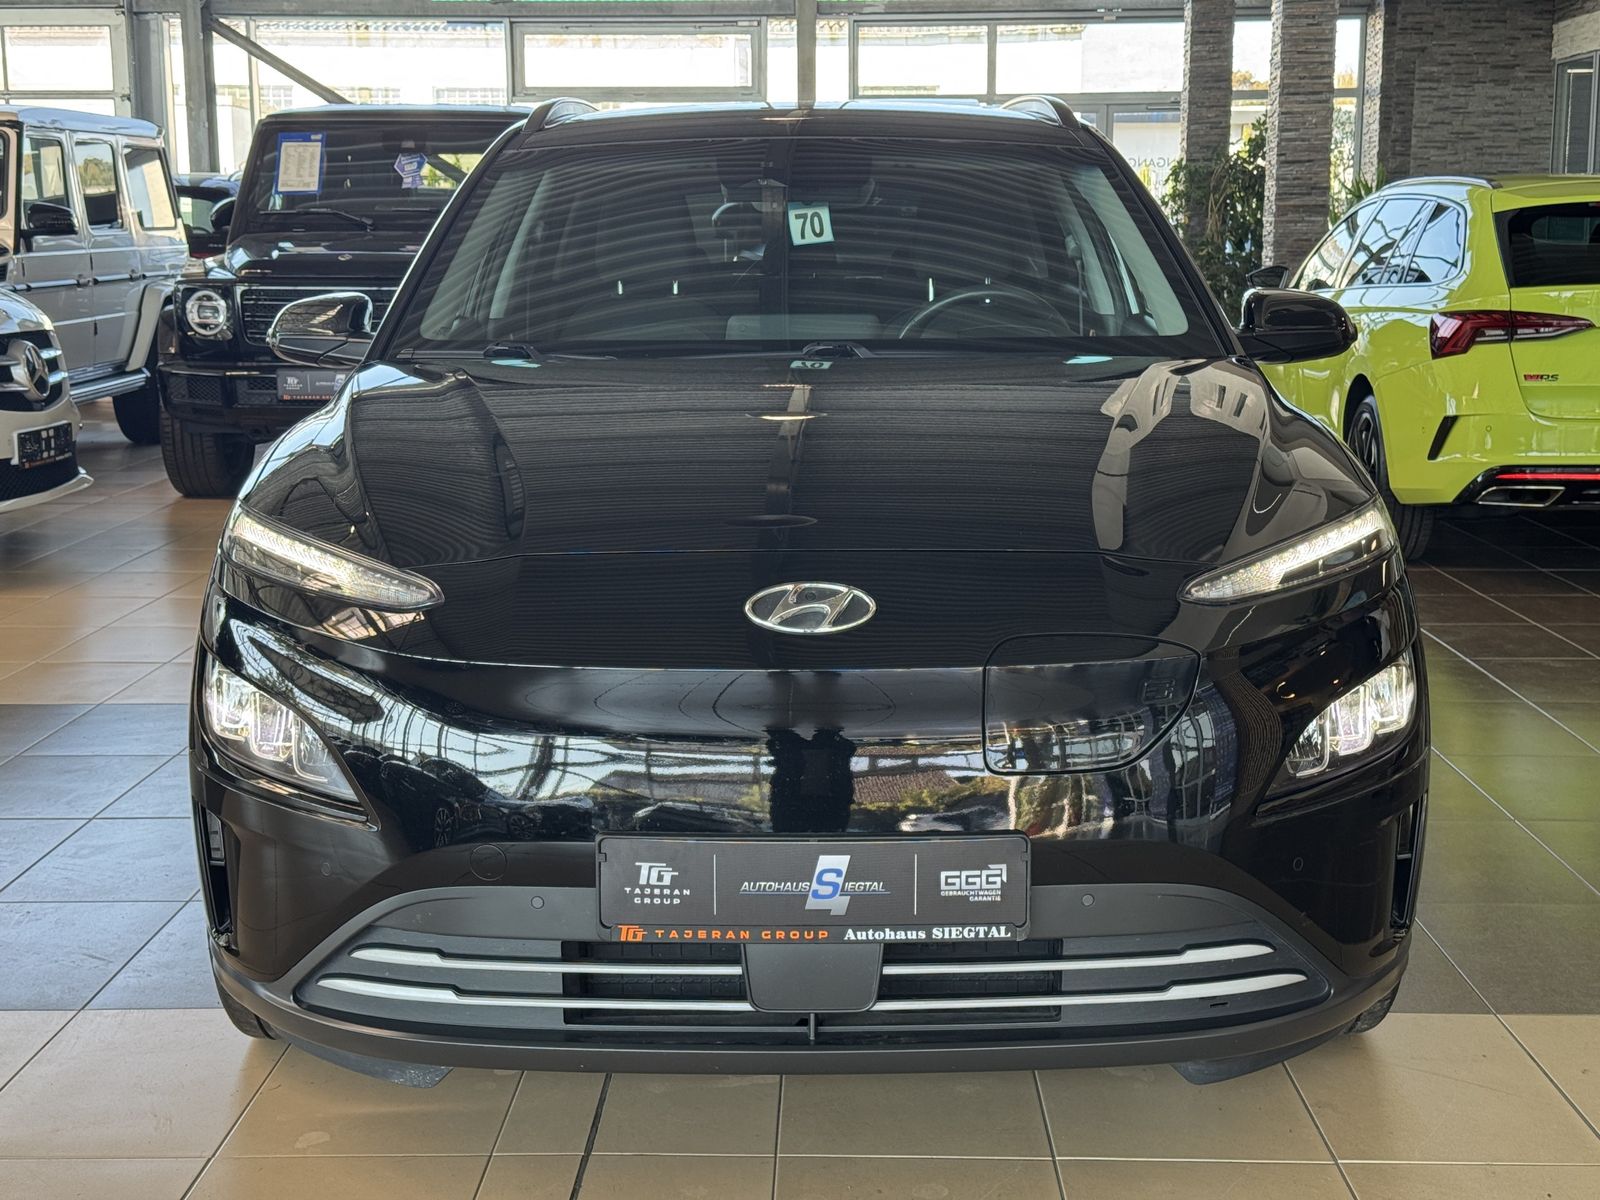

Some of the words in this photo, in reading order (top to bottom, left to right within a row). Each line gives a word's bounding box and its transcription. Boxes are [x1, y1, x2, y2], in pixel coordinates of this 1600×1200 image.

[794, 211, 825, 240] 70
[635, 862, 679, 885] TG
[940, 869, 1002, 890] GGG
[624, 887, 690, 896] TAJERAN
[740, 881, 810, 892] AUTOHAUS
[940, 889, 1002, 897] GEBRAUCHTWAGEN
[634, 897, 680, 905] GROUP
[618, 925, 648, 942] TG
[655, 929, 750, 940] TAJERAN
[761, 930, 829, 940] GROUP
[843, 928, 926, 941] Autohaus
[932, 926, 1011, 940] SIEGTAL
